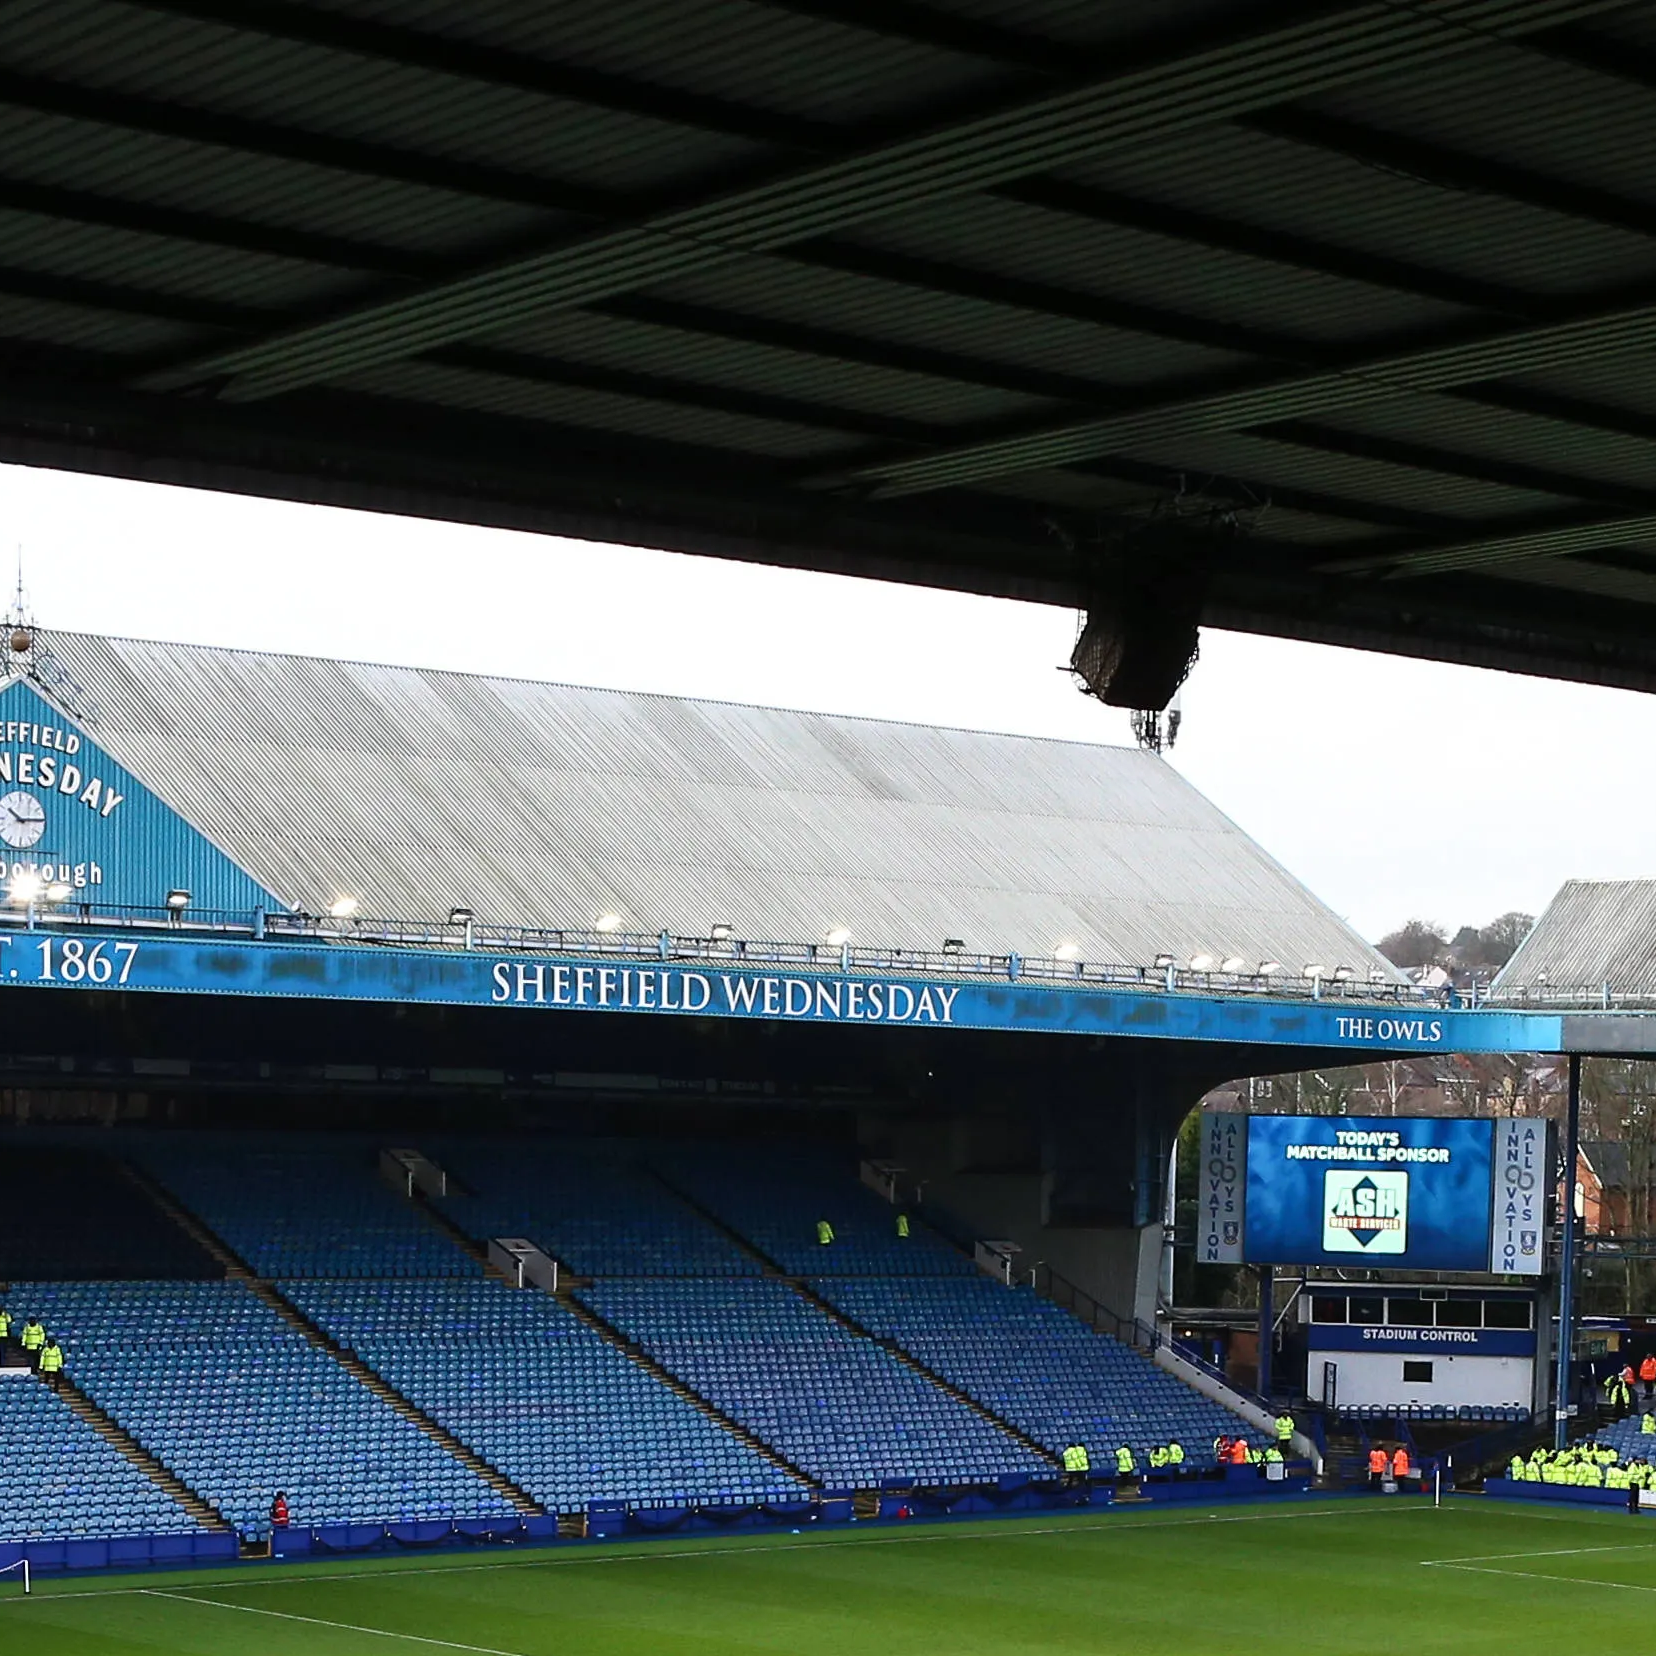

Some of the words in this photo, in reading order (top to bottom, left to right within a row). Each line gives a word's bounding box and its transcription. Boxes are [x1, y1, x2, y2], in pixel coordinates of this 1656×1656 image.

[36, 939, 139, 984] 1867
[492, 962, 710, 1011] SHEFFIELD
[720, 975, 960, 1023] WEDNESDAY
[1335, 1017, 1373, 1038] THE
[1378, 1019, 1442, 1042] OWLS
[1286, 1145, 1375, 1160] MATCHBALL
[1377, 1147, 1450, 1162] SPONSOR
[1336, 1131, 1400, 1146] TODAY'S
[1517, 1128, 1535, 1221] ALLOYS
[1335, 1187, 1397, 1218] ASH
[1503, 1120, 1521, 1271] INNOVATION
[1363, 1328, 1417, 1340] STADIUM
[1420, 1330, 1478, 1342] CONTROL
